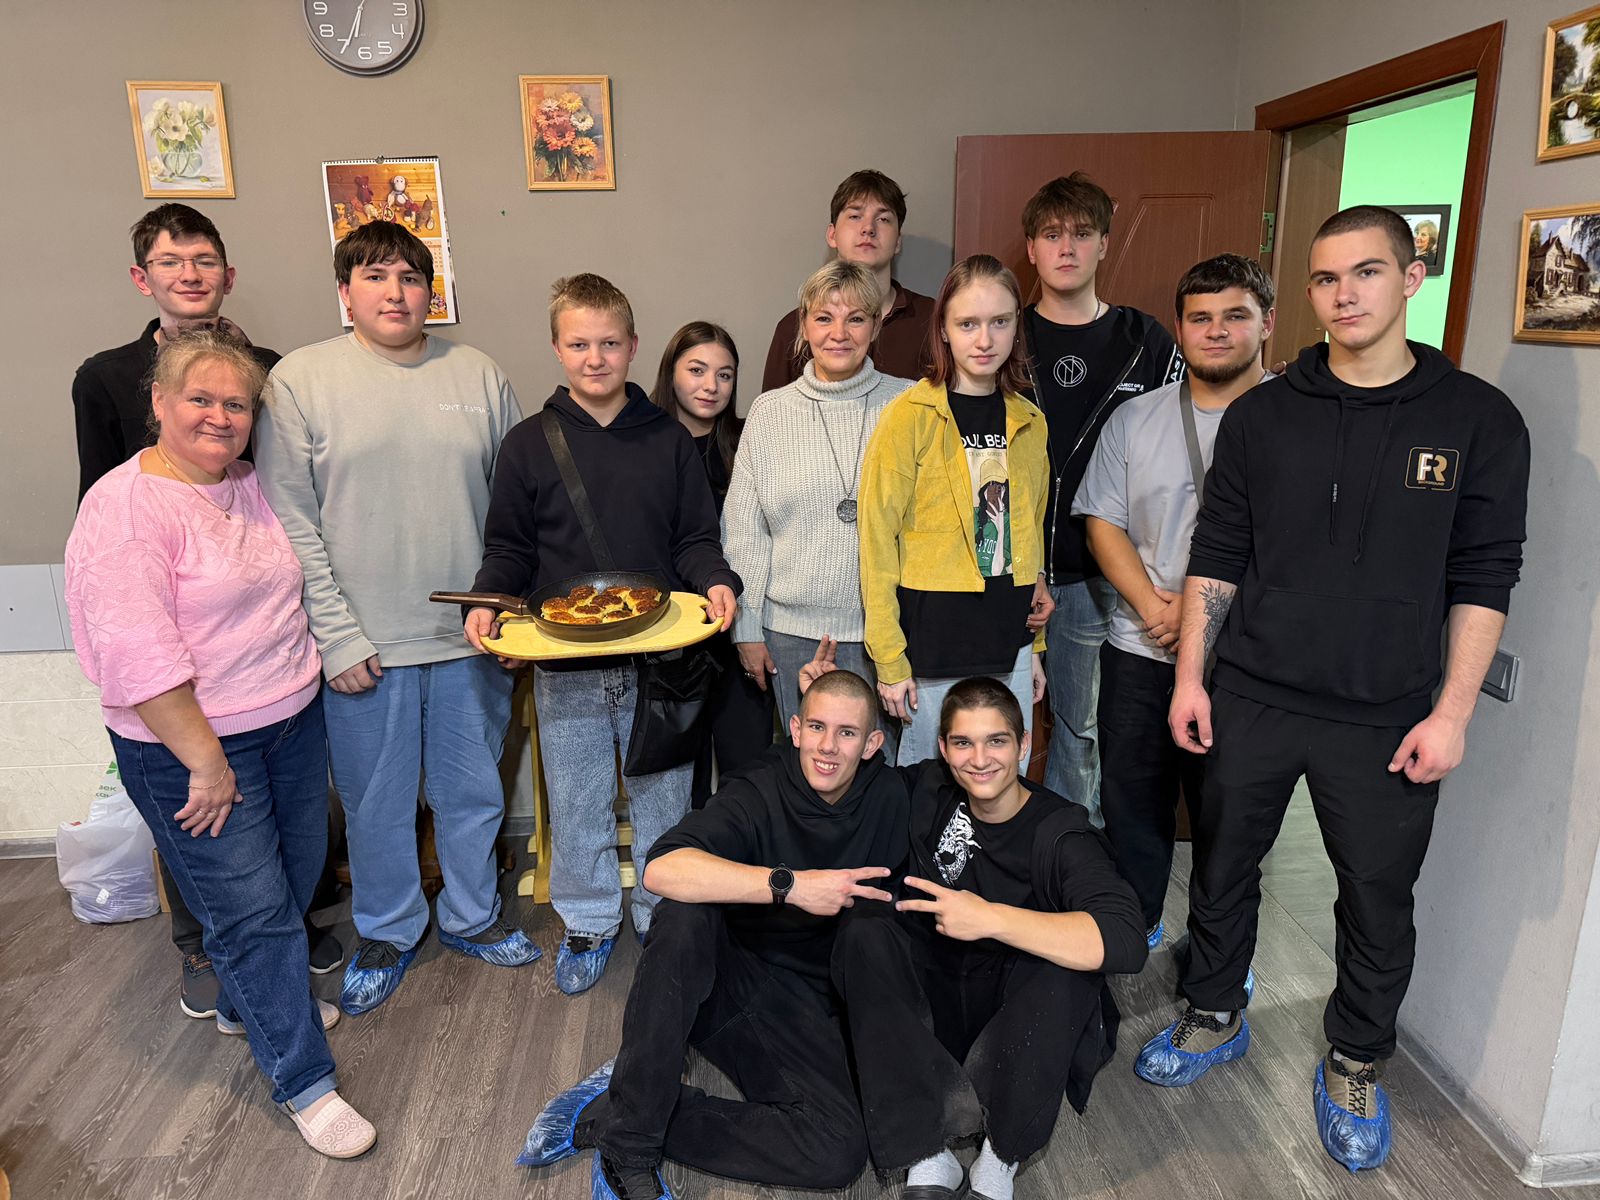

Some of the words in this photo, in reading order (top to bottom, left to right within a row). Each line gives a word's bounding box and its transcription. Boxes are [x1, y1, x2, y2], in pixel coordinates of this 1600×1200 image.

[313, 1, 328, 15] 9
[392, 2, 408, 16] 3
[319, 24, 335, 38] 8
[391, 23, 405, 40] 4
[336, 38, 350, 54] 7
[357, 46, 373, 60] 6
[377, 41, 393, 55] 5
